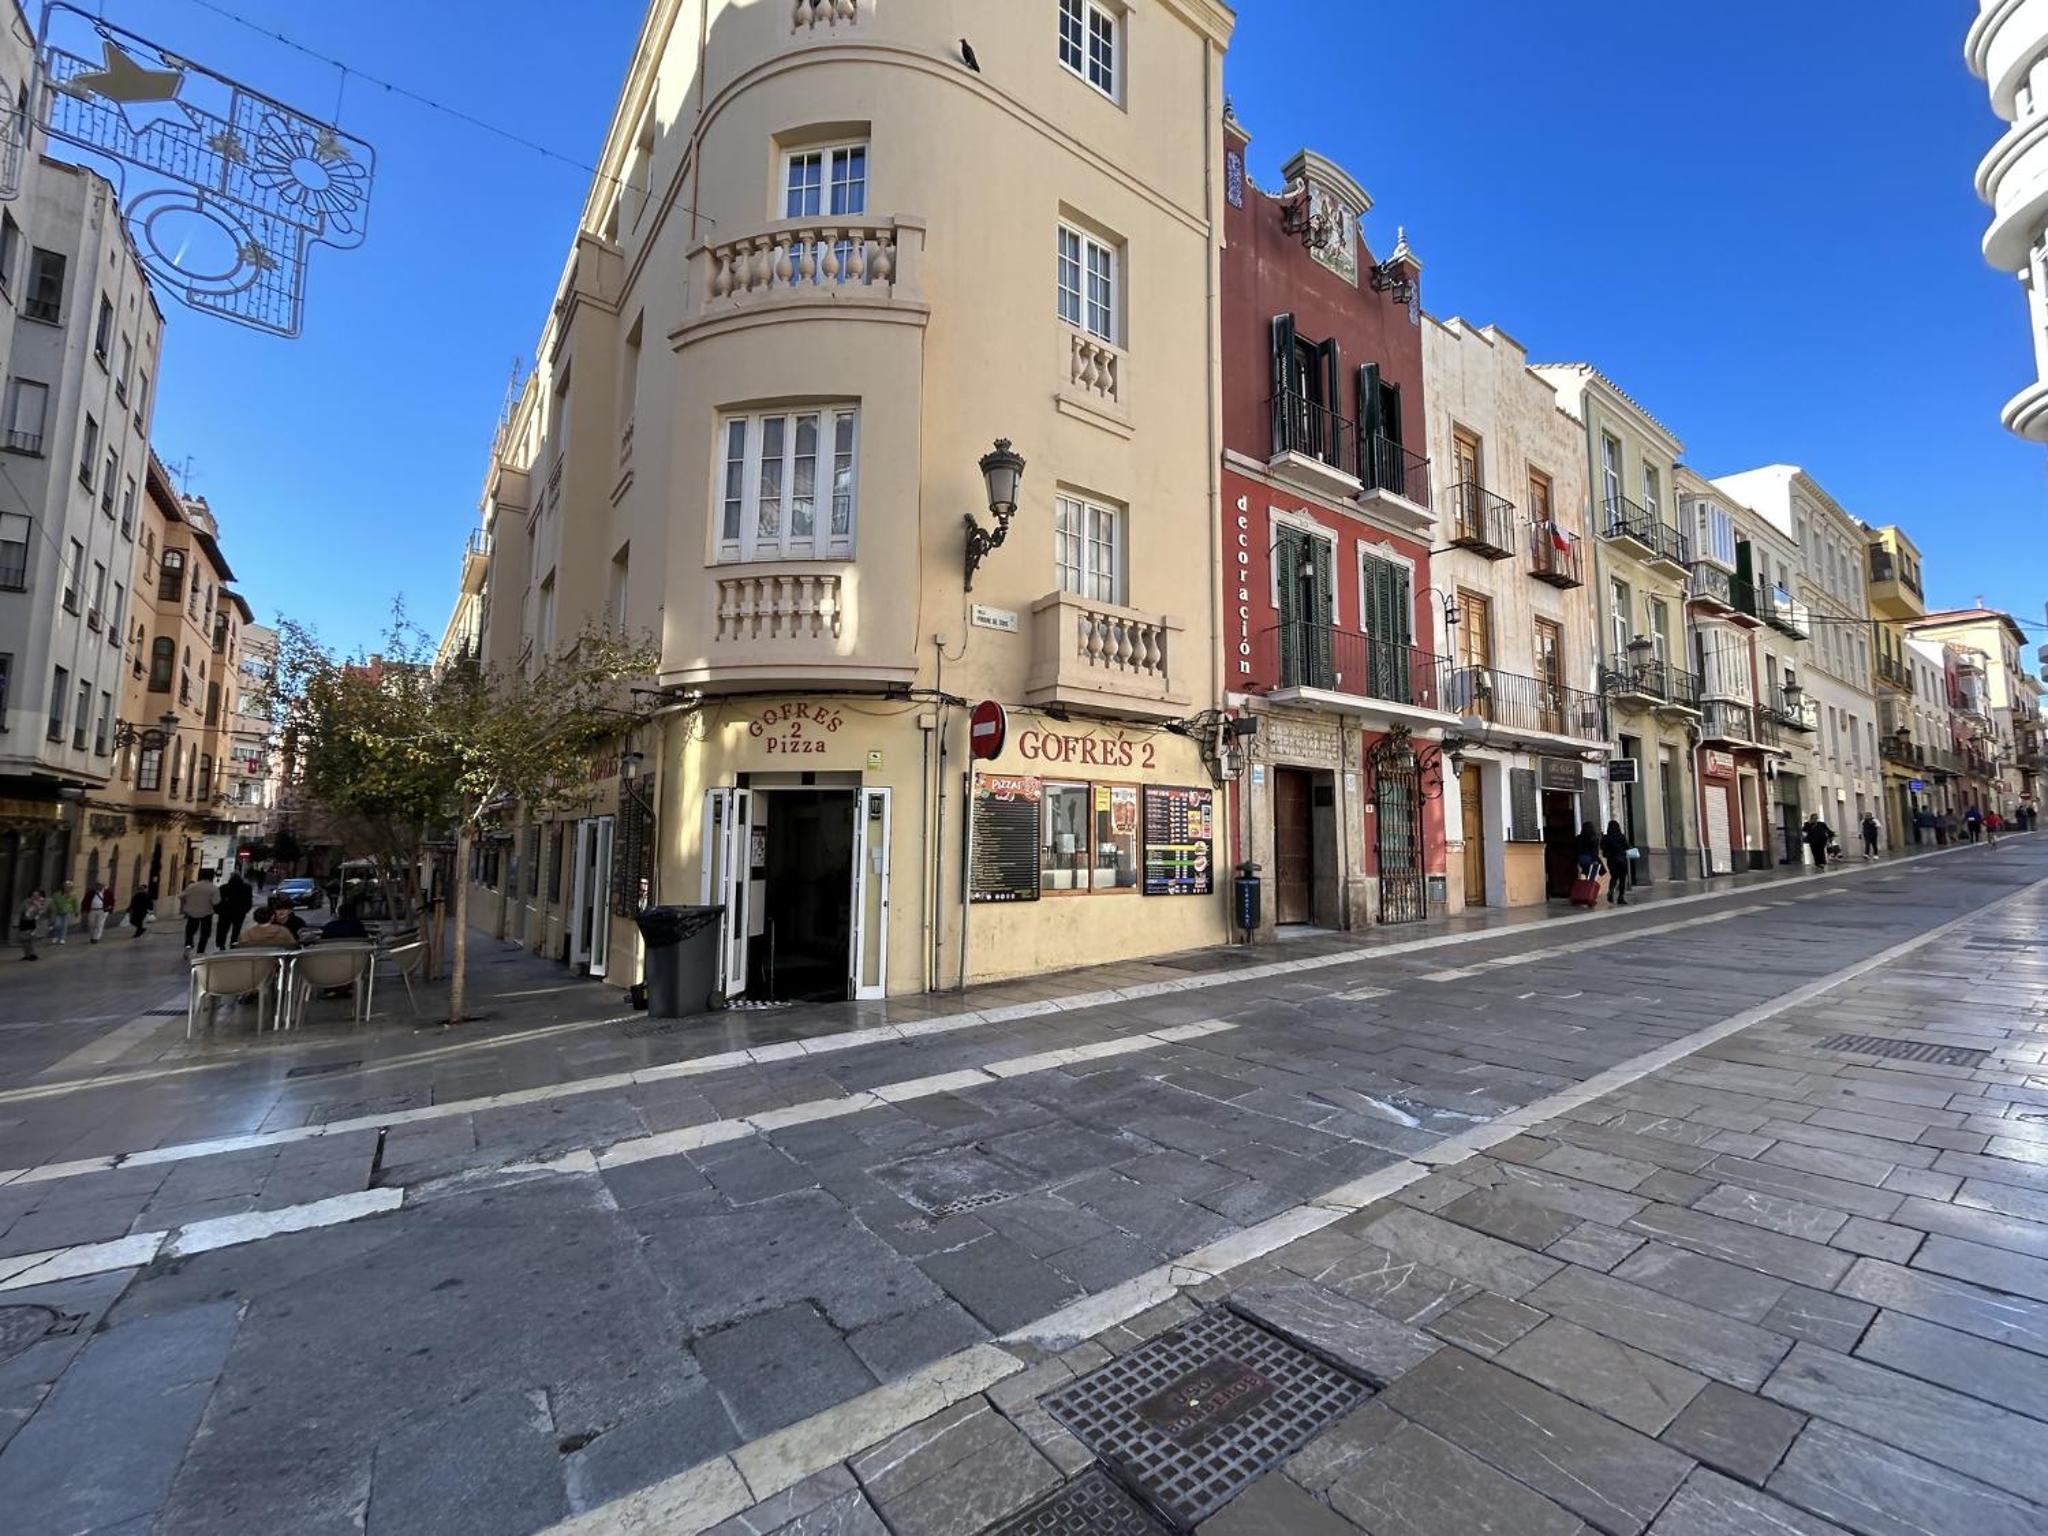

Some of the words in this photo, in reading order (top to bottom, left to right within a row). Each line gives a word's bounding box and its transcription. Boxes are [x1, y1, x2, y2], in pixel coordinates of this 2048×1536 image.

[1236, 495, 1251, 674] decoración
[791, 722, 802, 738] 2
[766, 735, 826, 753] Pizza
[1142, 743, 1156, 769] 2
